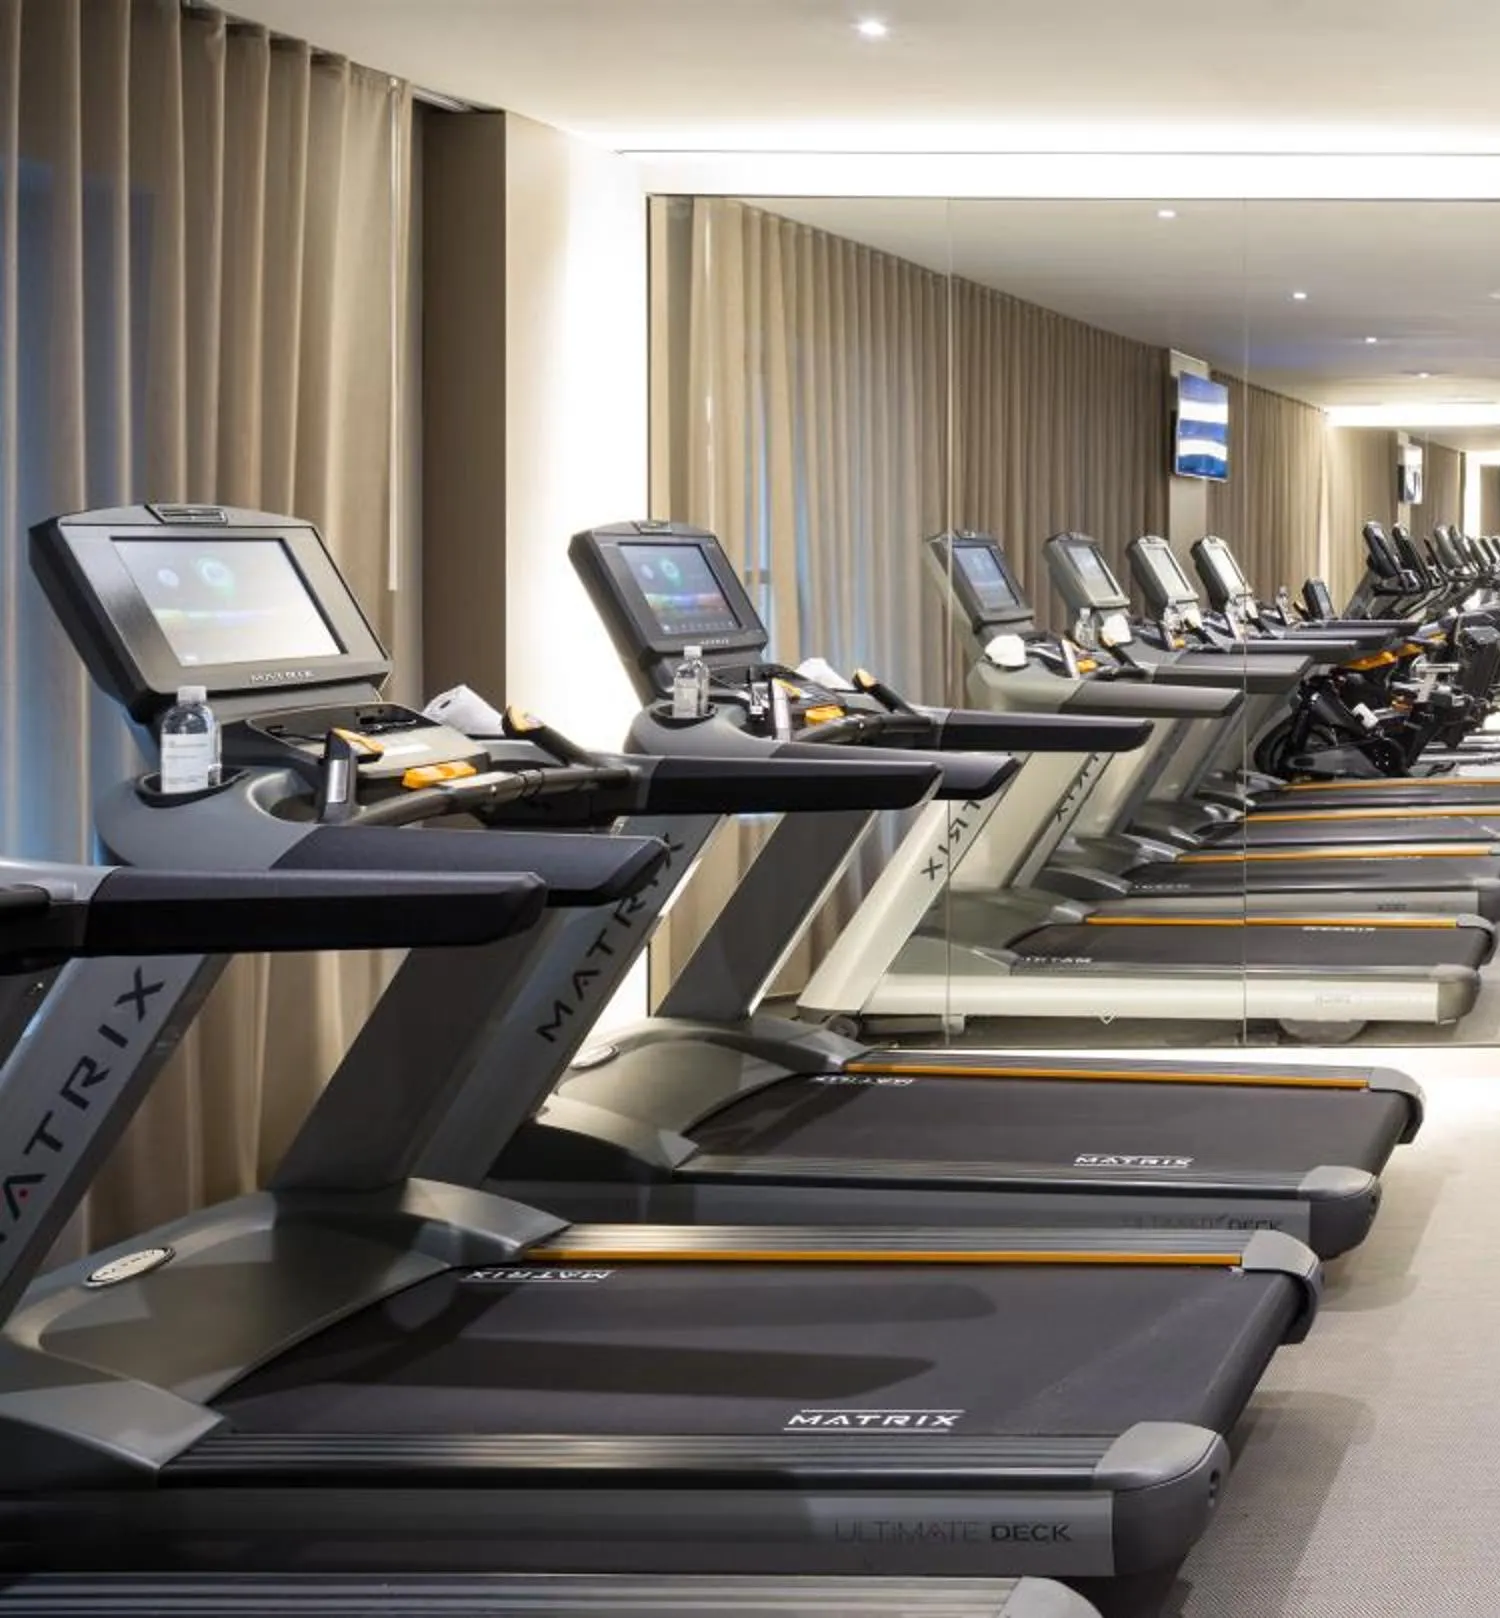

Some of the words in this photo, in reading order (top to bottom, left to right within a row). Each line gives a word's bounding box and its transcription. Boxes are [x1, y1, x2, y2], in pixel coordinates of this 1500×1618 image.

[0, 965, 165, 1245] ATRIX
[787, 1413, 960, 1426] MATRIX
[834, 1518, 977, 1543] ULTIMATE
[989, 1522, 1073, 1543] DECK
